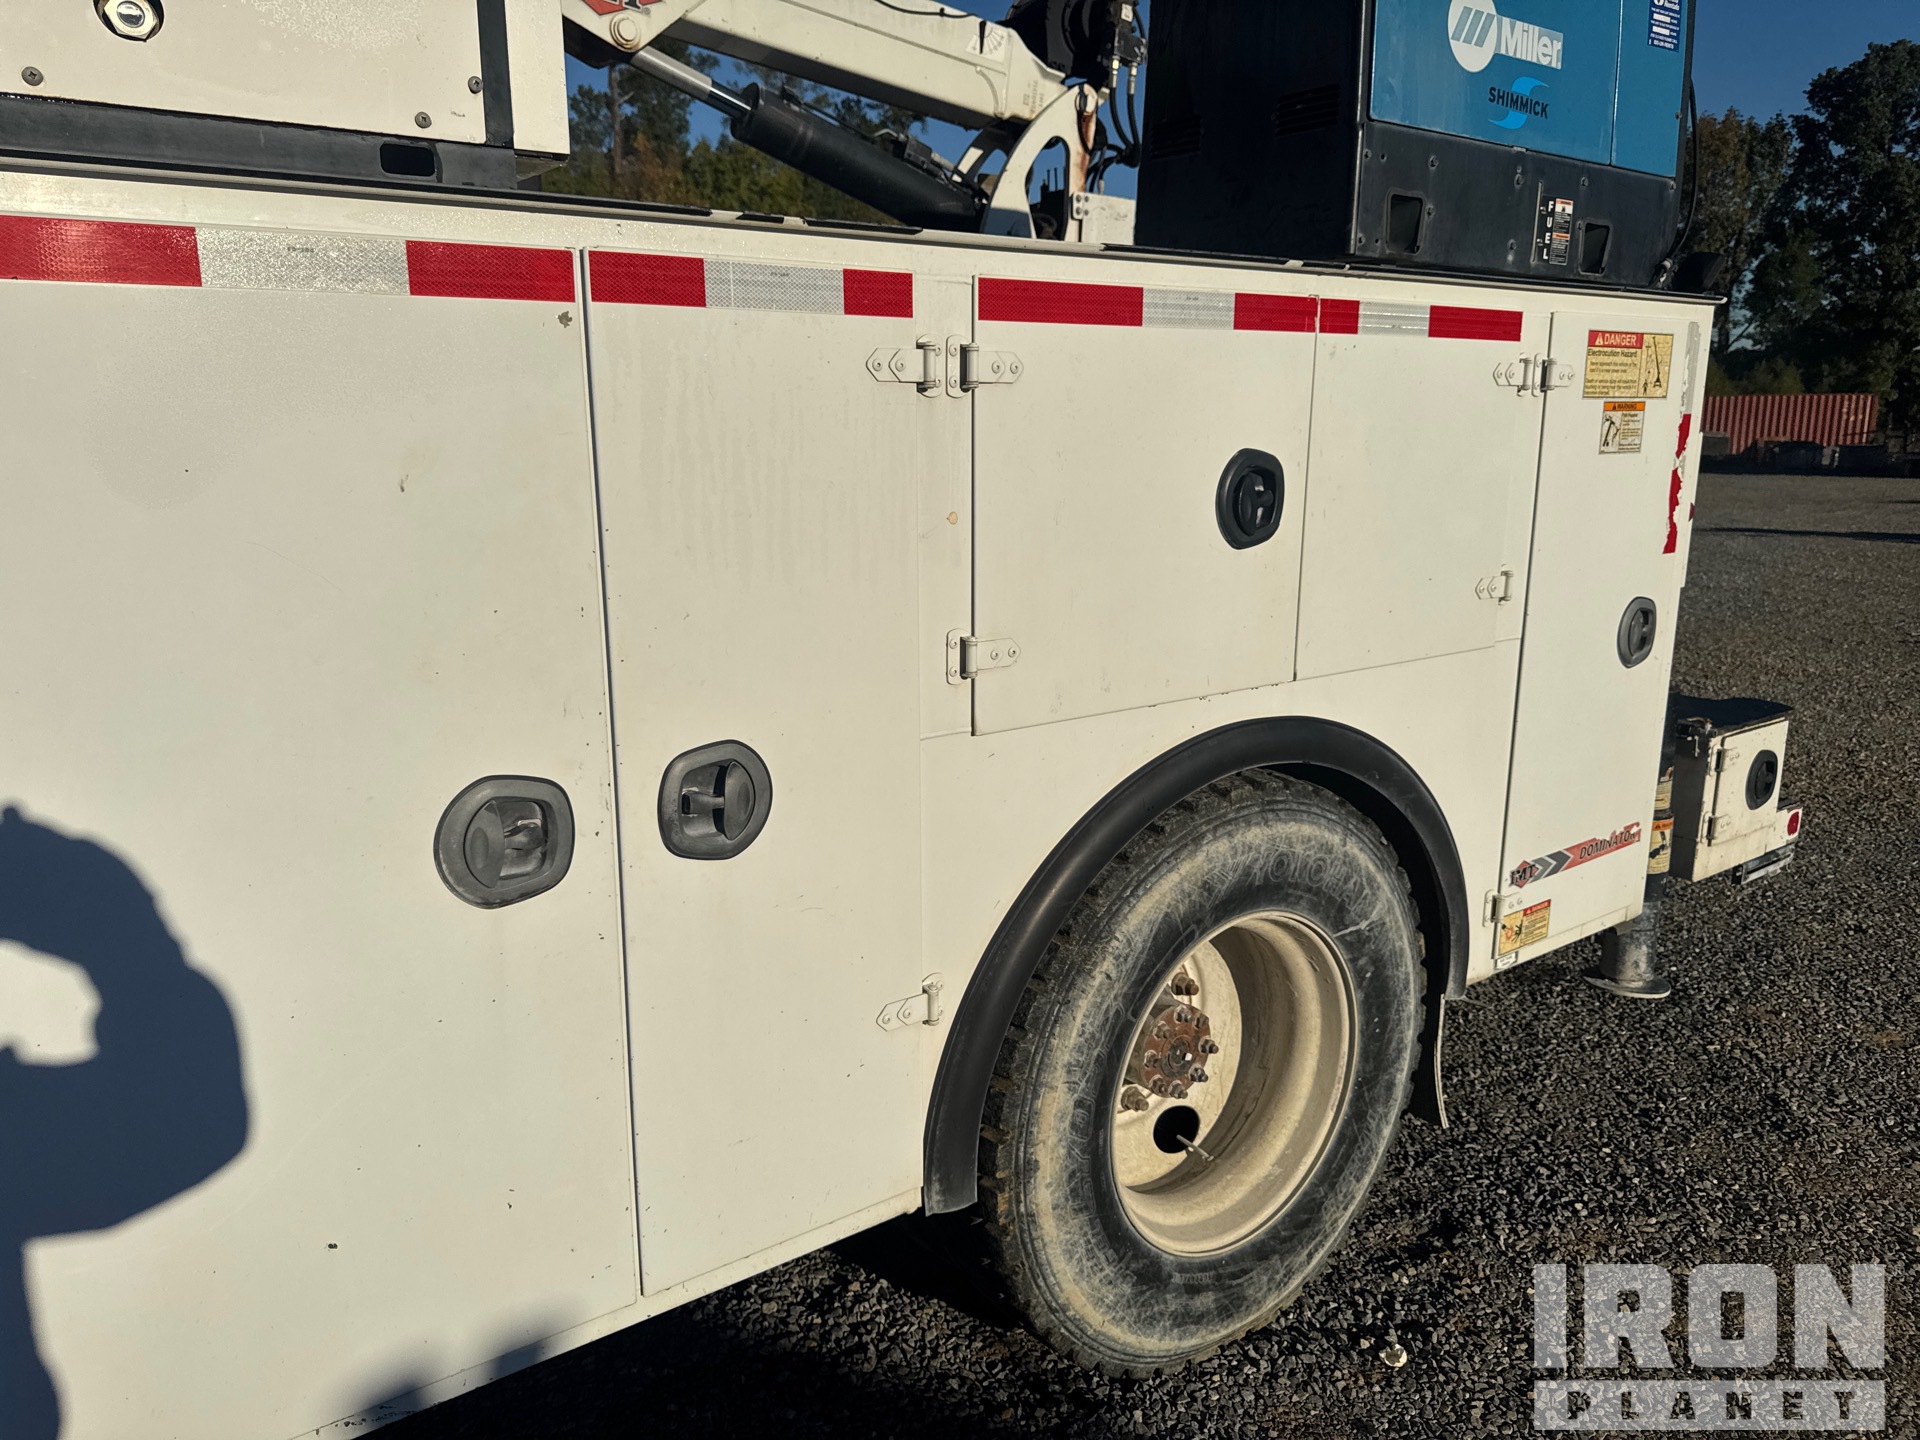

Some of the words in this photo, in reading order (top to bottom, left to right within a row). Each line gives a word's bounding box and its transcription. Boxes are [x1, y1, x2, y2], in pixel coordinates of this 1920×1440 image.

[1501, 17, 1561, 68] Miller
[1488, 86, 1549, 119] SHIMMICK
[1543, 201, 1554, 260] FUEL
[1604, 333, 1637, 346] DANGER
[1621, 350, 1638, 358] Hazard
